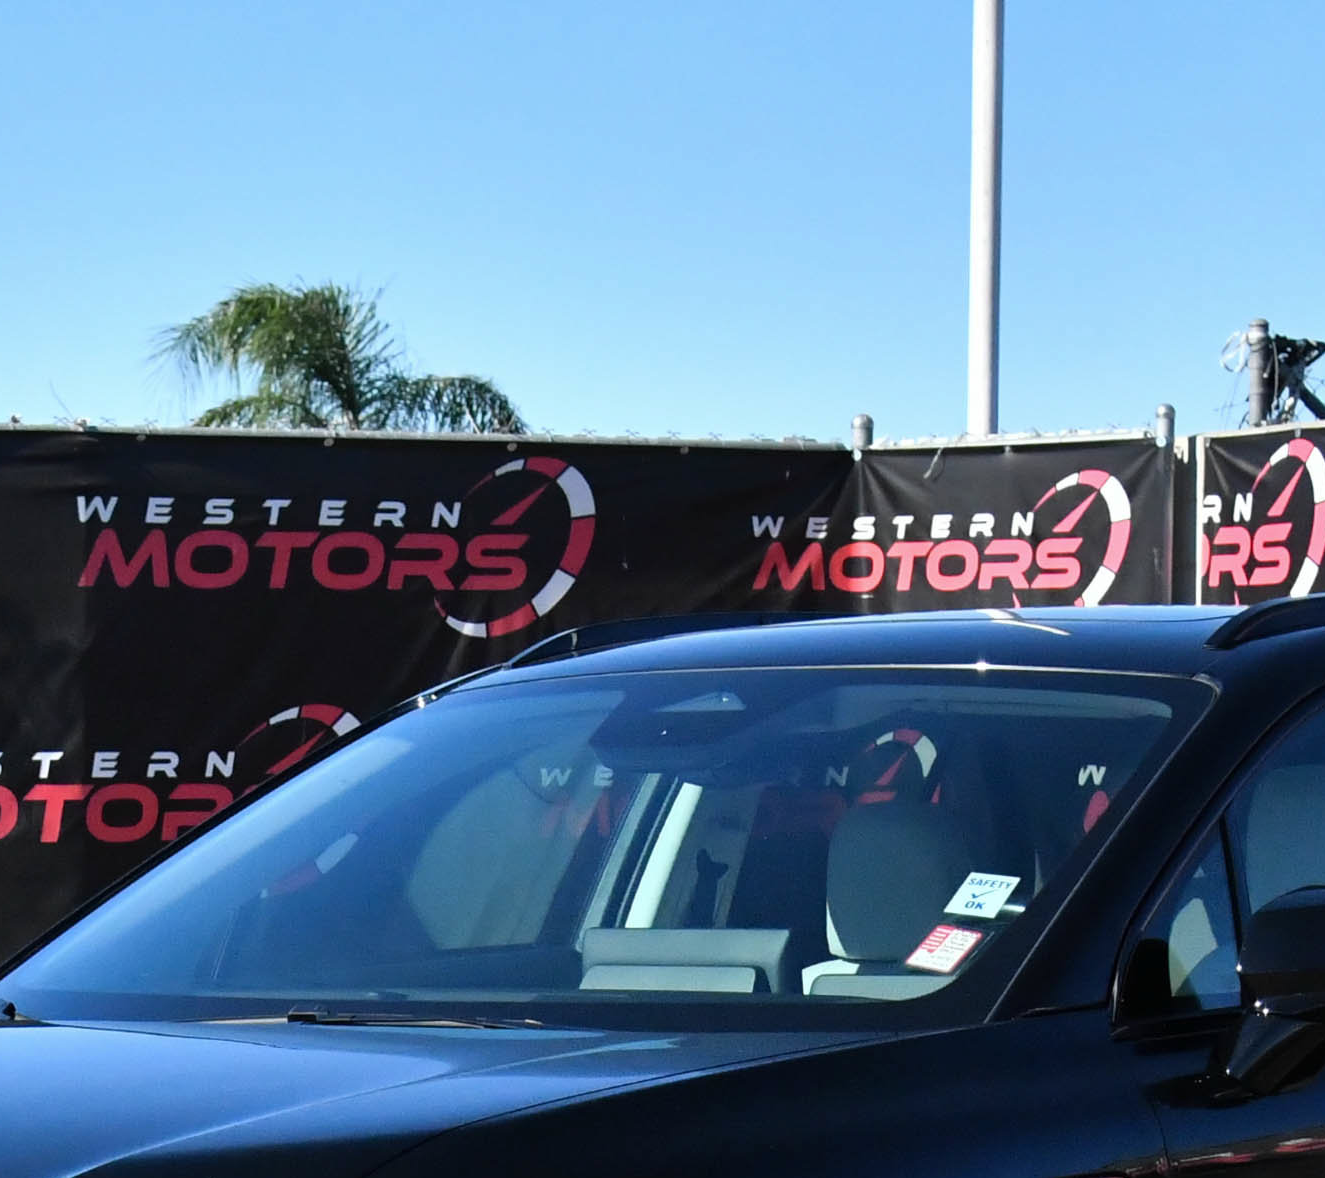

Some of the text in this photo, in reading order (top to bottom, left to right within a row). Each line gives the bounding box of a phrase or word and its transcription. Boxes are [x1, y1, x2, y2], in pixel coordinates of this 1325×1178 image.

[77, 496, 460, 527] WESTERN
[753, 511, 1034, 540] WESTERN
[79, 529, 527, 590] MOTORS
[754, 536, 1082, 591] MOTORS
[1203, 521, 1293, 588] RS
[969, 878, 1012, 890] SAFETY
[964, 901, 986, 910] OK
